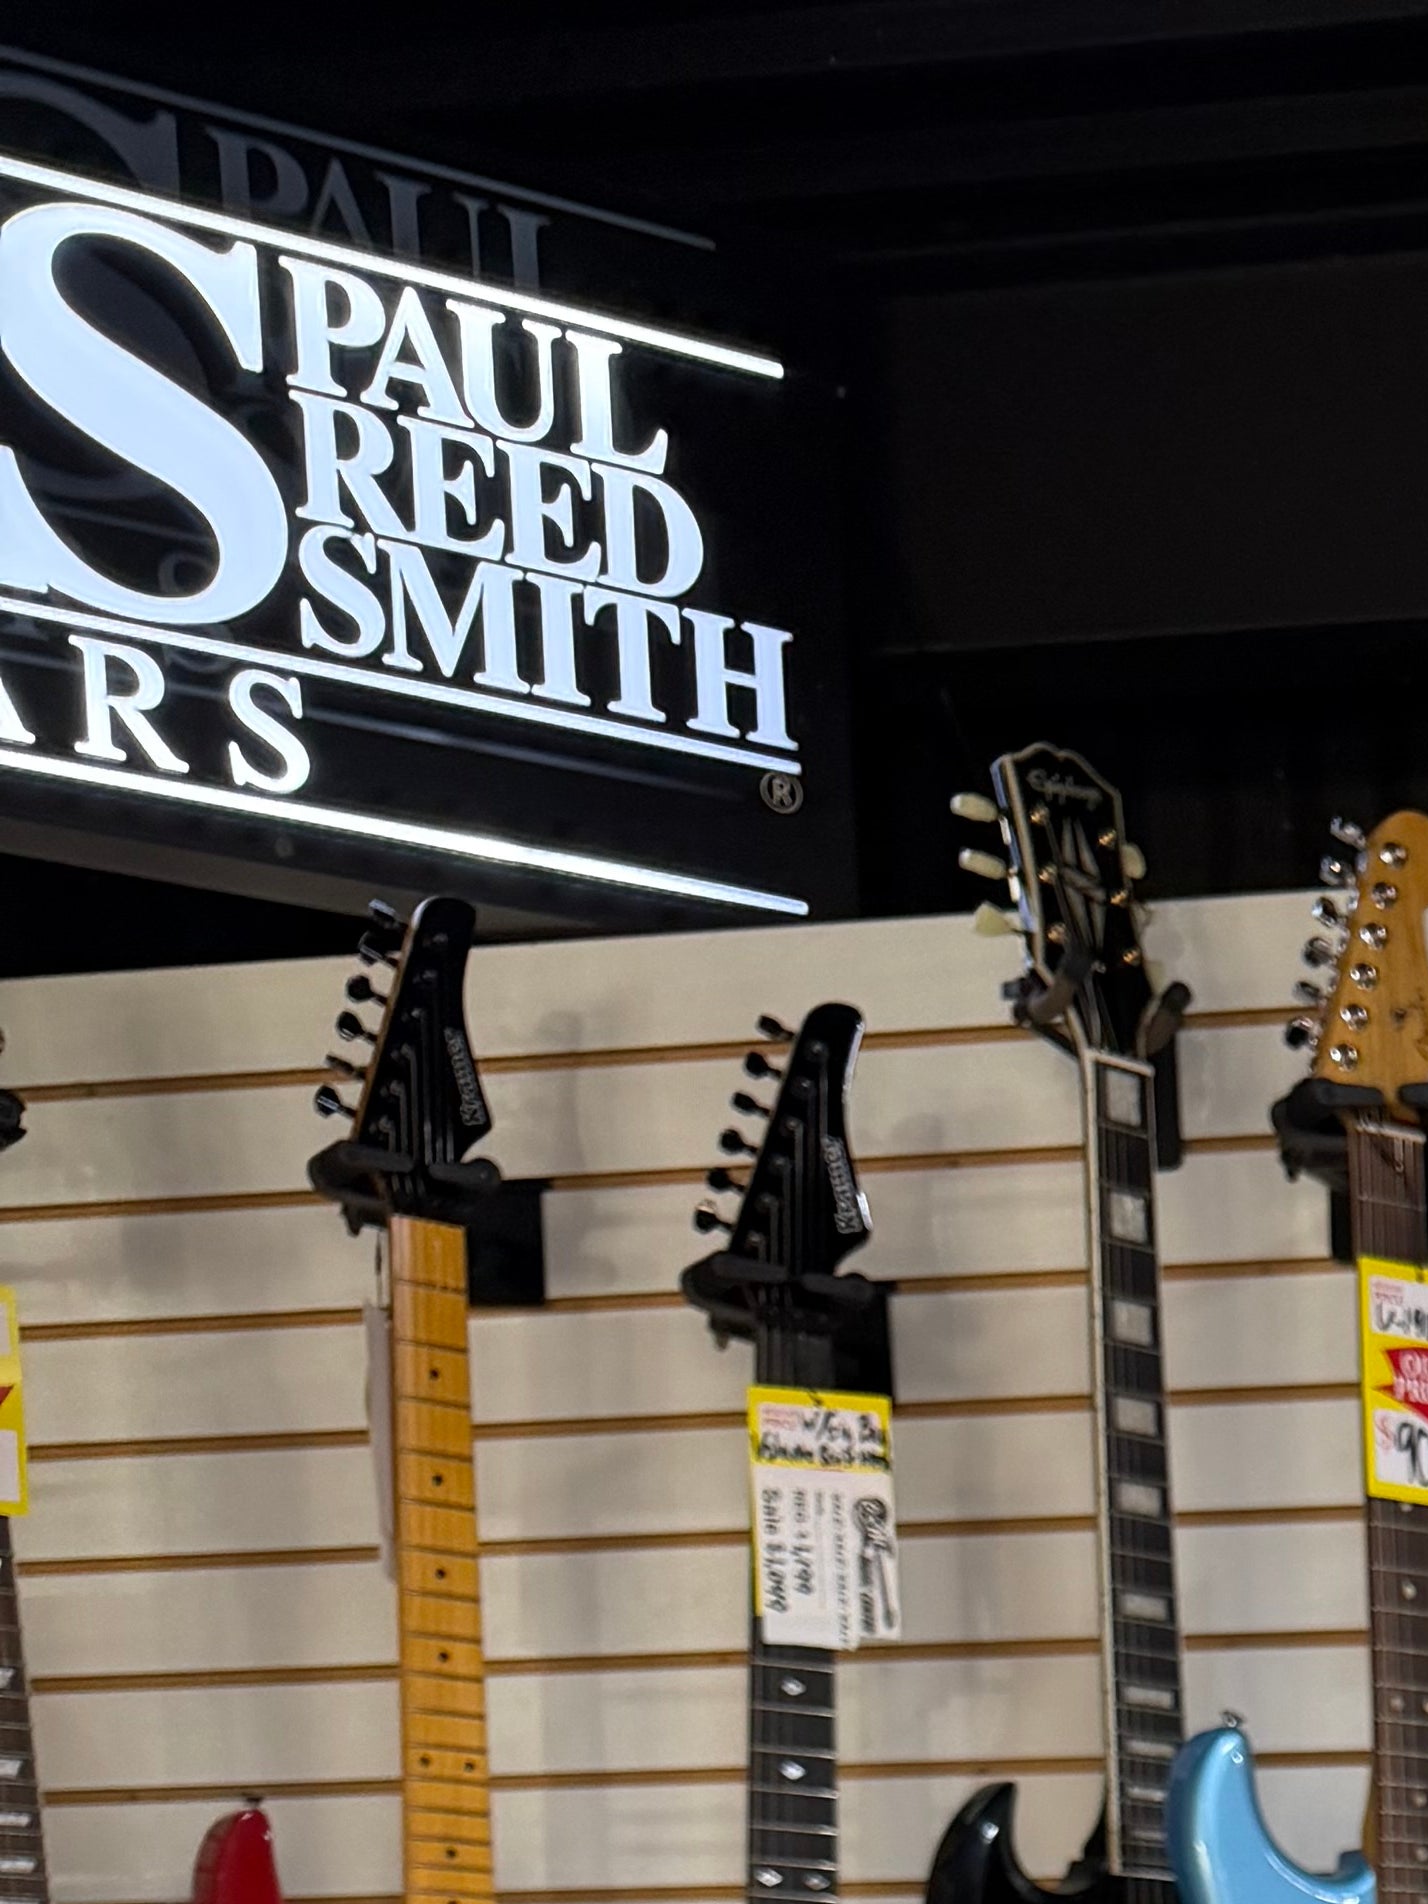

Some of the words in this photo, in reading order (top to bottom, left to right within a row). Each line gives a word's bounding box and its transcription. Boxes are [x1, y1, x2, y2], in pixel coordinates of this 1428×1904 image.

[279, 254, 667, 475] PAUL
[289, 389, 704, 598] REED
[298, 525, 799, 751] SMITH
